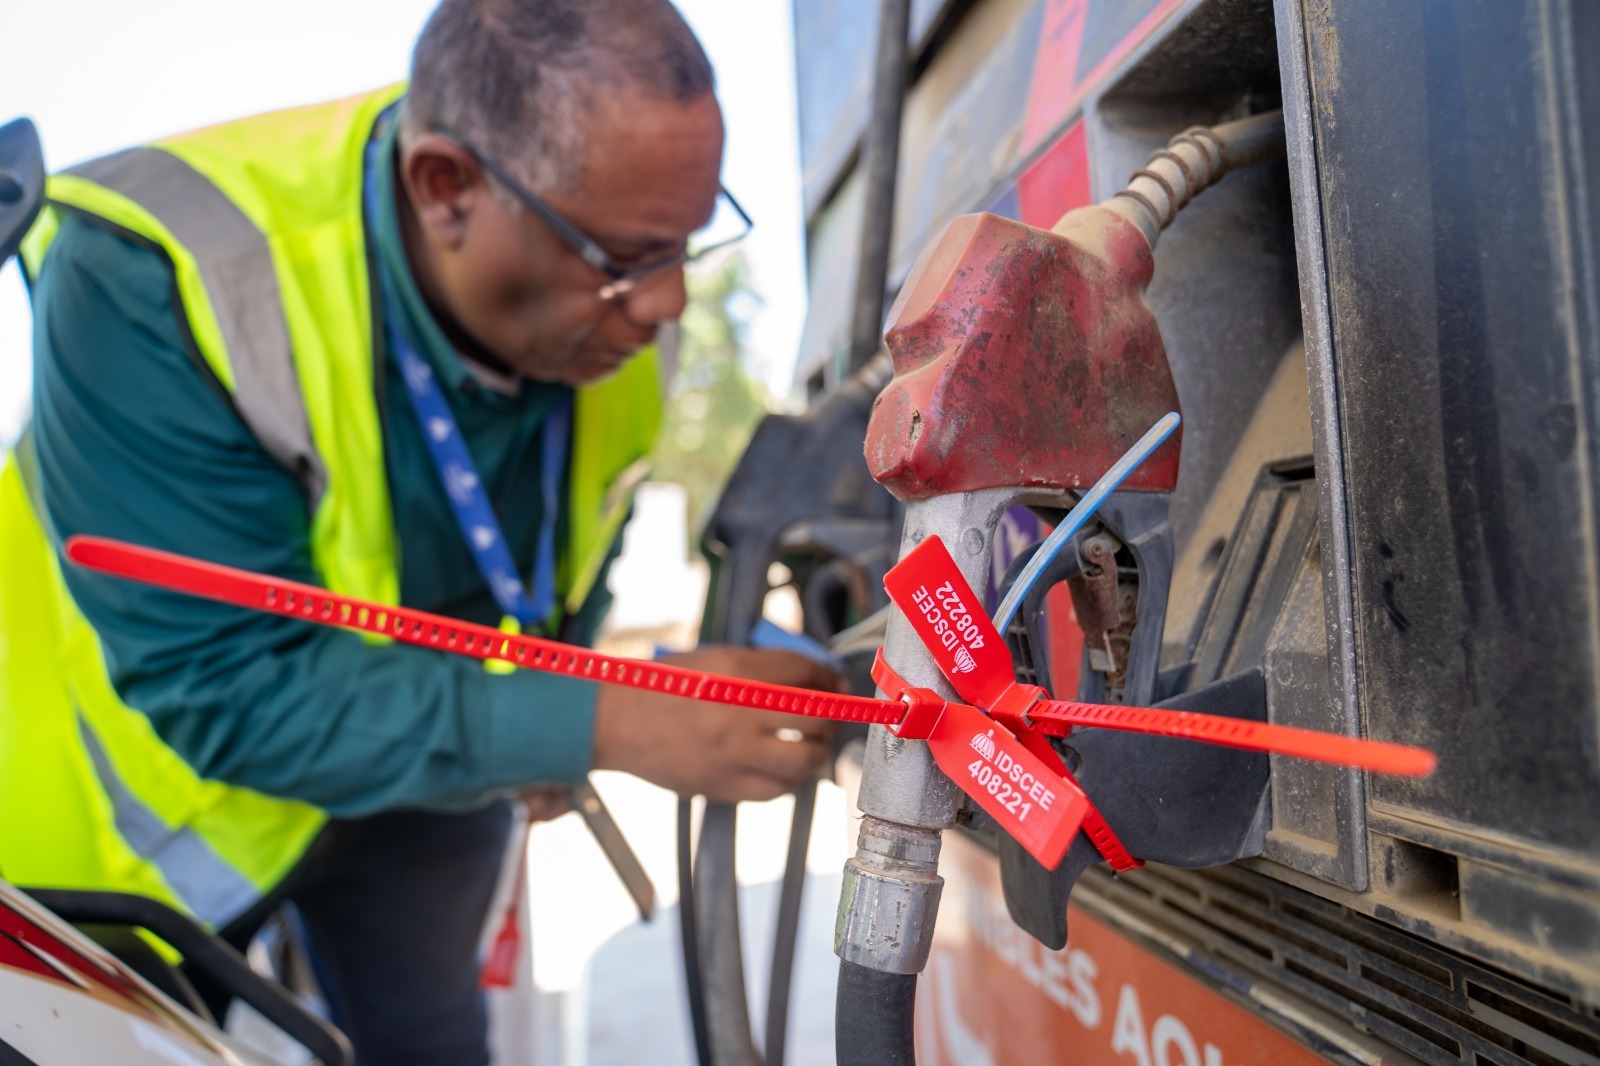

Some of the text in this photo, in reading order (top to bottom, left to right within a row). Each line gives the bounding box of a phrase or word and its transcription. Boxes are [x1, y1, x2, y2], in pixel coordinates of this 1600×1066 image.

[911, 585, 960, 652] IDSCEE
[936, 580, 985, 649] 408222
[967, 759, 1032, 822] 408221
[994, 750, 1056, 811] IDSCEE
[1111, 982, 1224, 1066] AQ
